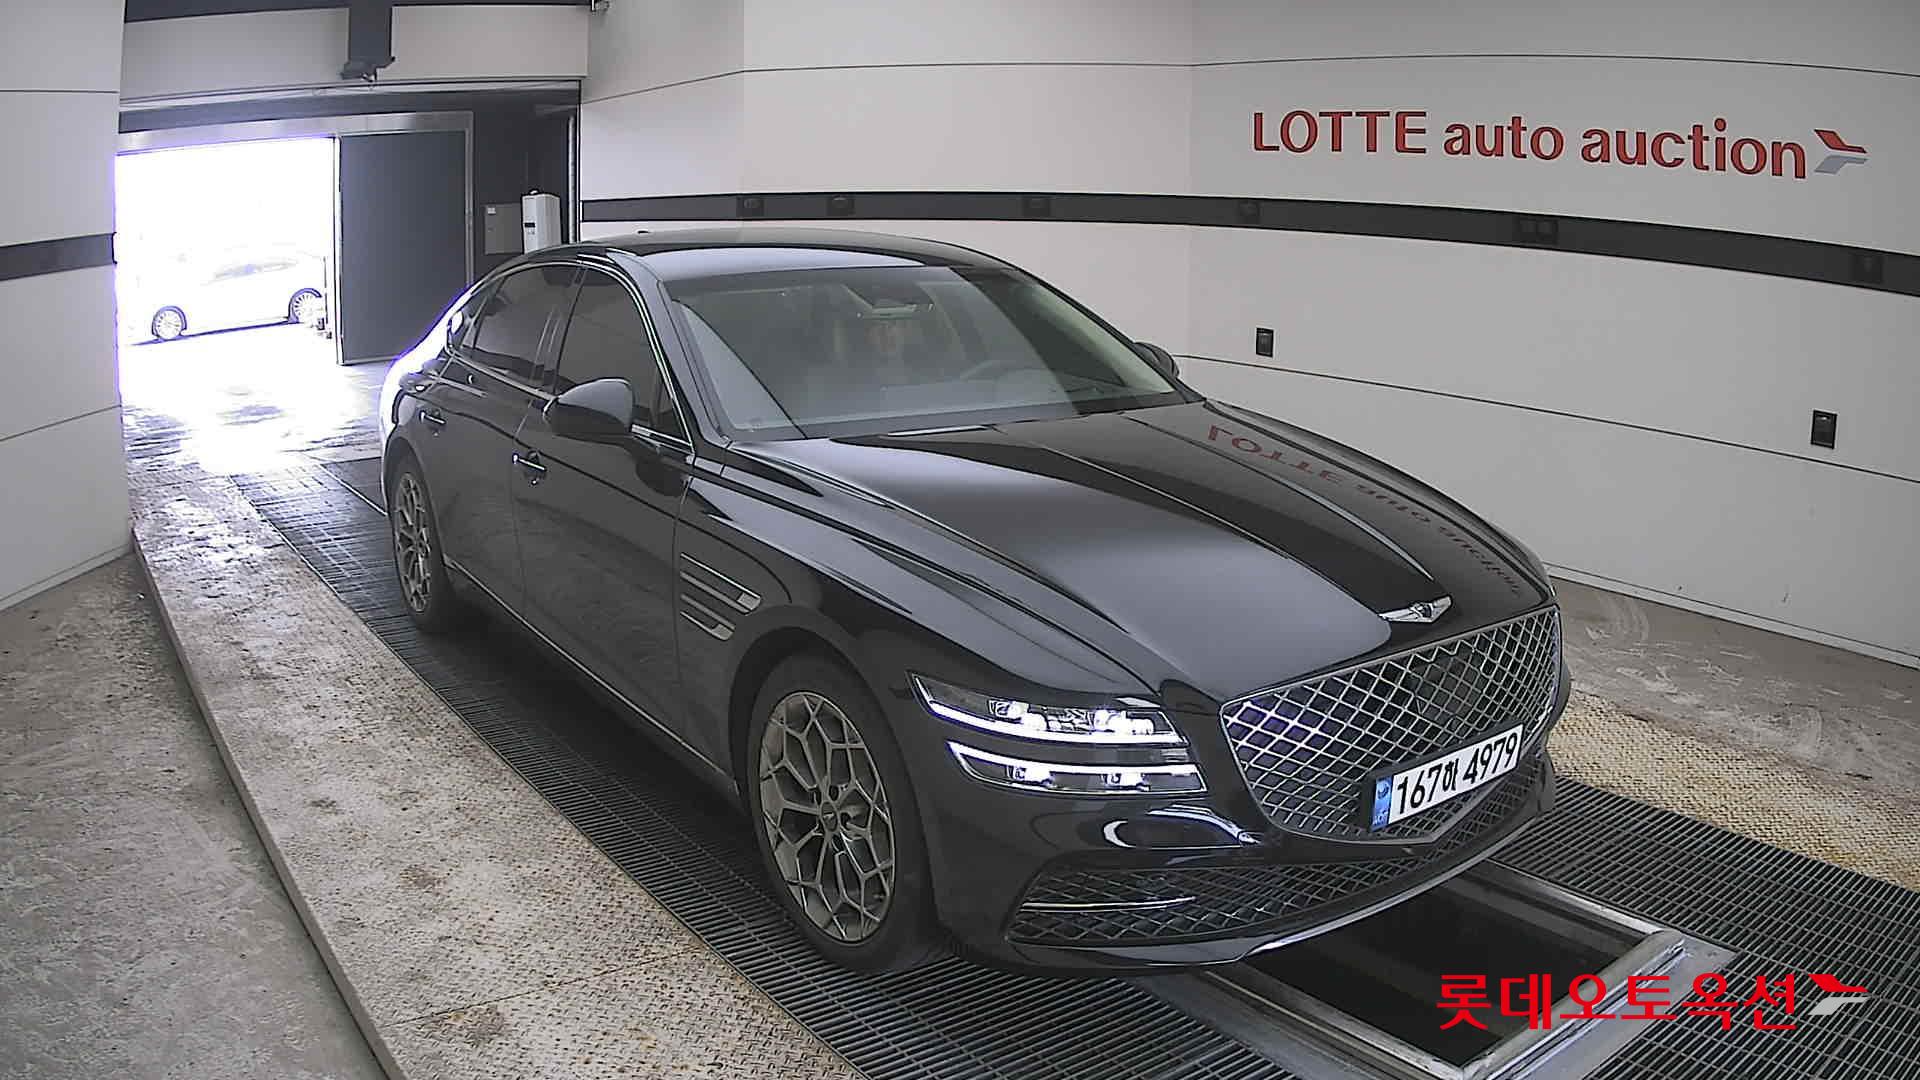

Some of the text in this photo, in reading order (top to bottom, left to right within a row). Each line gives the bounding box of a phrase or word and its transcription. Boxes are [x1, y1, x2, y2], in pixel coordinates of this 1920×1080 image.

[1253, 110, 1807, 179] LOTTE auto auction
[1462, 732, 1519, 785] 4979
